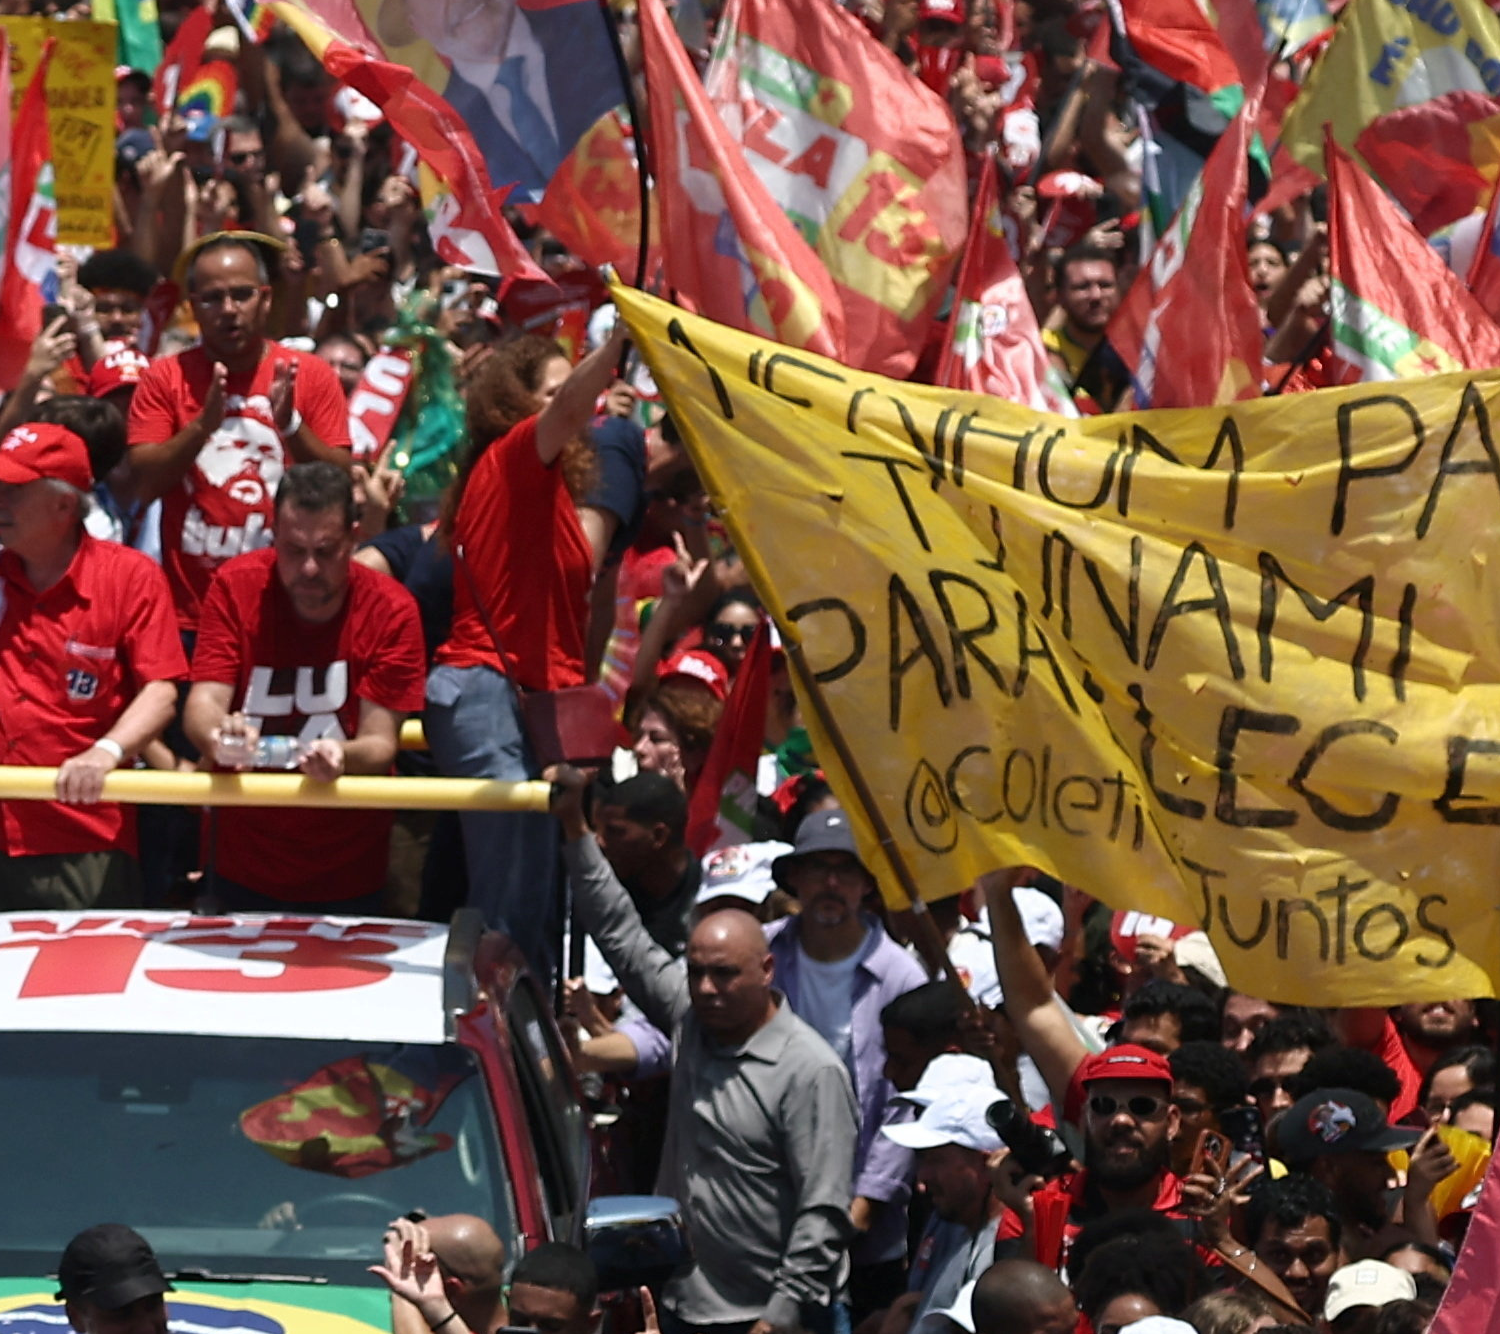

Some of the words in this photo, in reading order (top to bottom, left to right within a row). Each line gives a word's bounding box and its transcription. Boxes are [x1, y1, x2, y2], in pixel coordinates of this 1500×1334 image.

[346, 355, 411, 454] ULA
[66, 669, 97, 699] 13
[244, 661, 348, 716] LU
